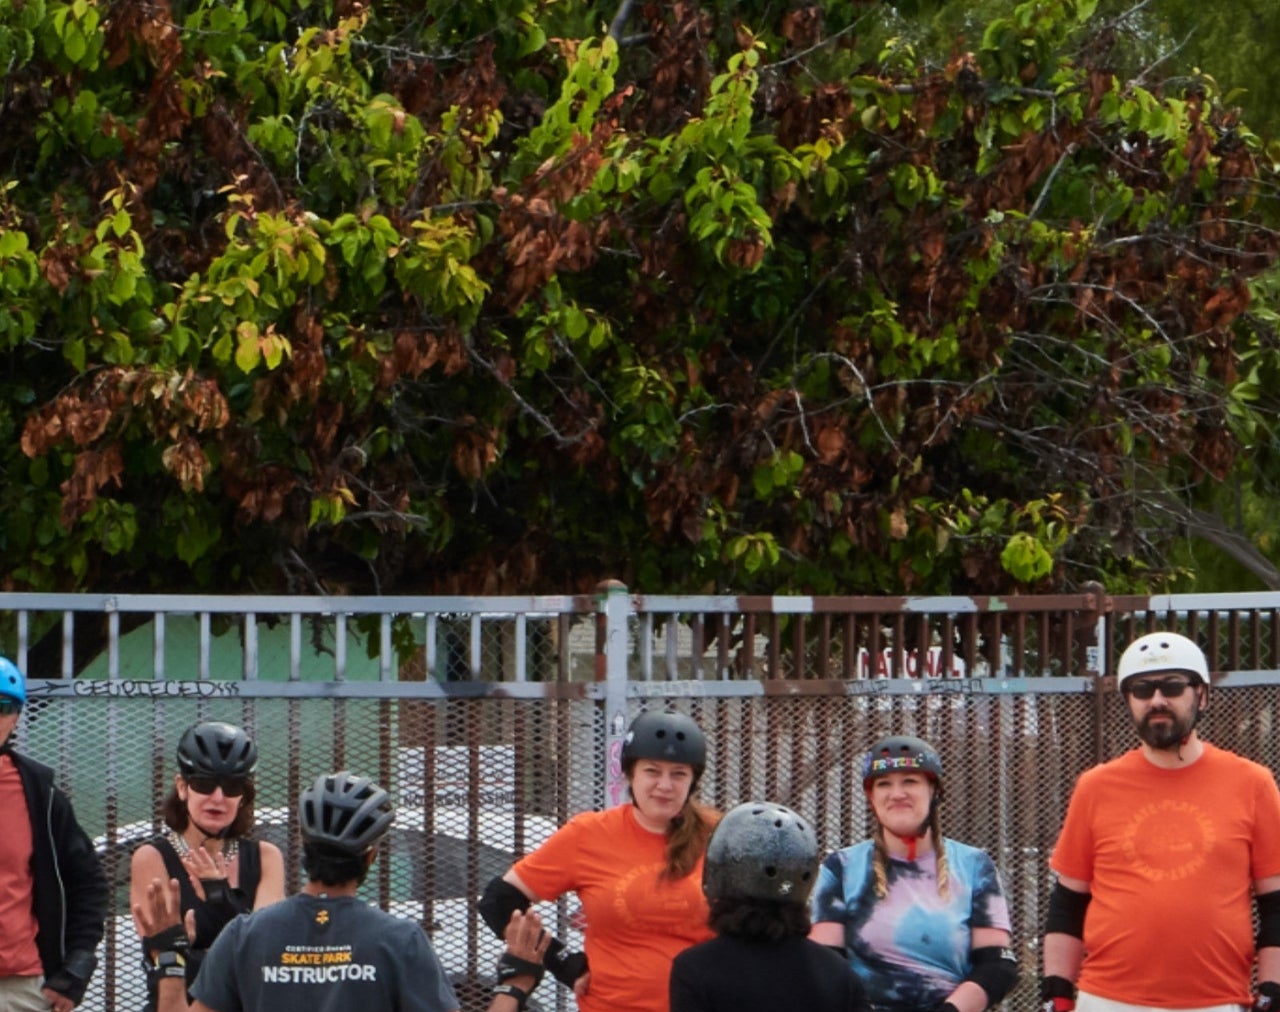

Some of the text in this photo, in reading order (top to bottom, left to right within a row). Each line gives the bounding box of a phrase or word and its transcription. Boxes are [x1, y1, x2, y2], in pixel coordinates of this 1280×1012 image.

[861, 651, 960, 677] NAONAL
[281, 951, 352, 965] SKATE PARK
[262, 963, 376, 984] NSTRUCTOR
